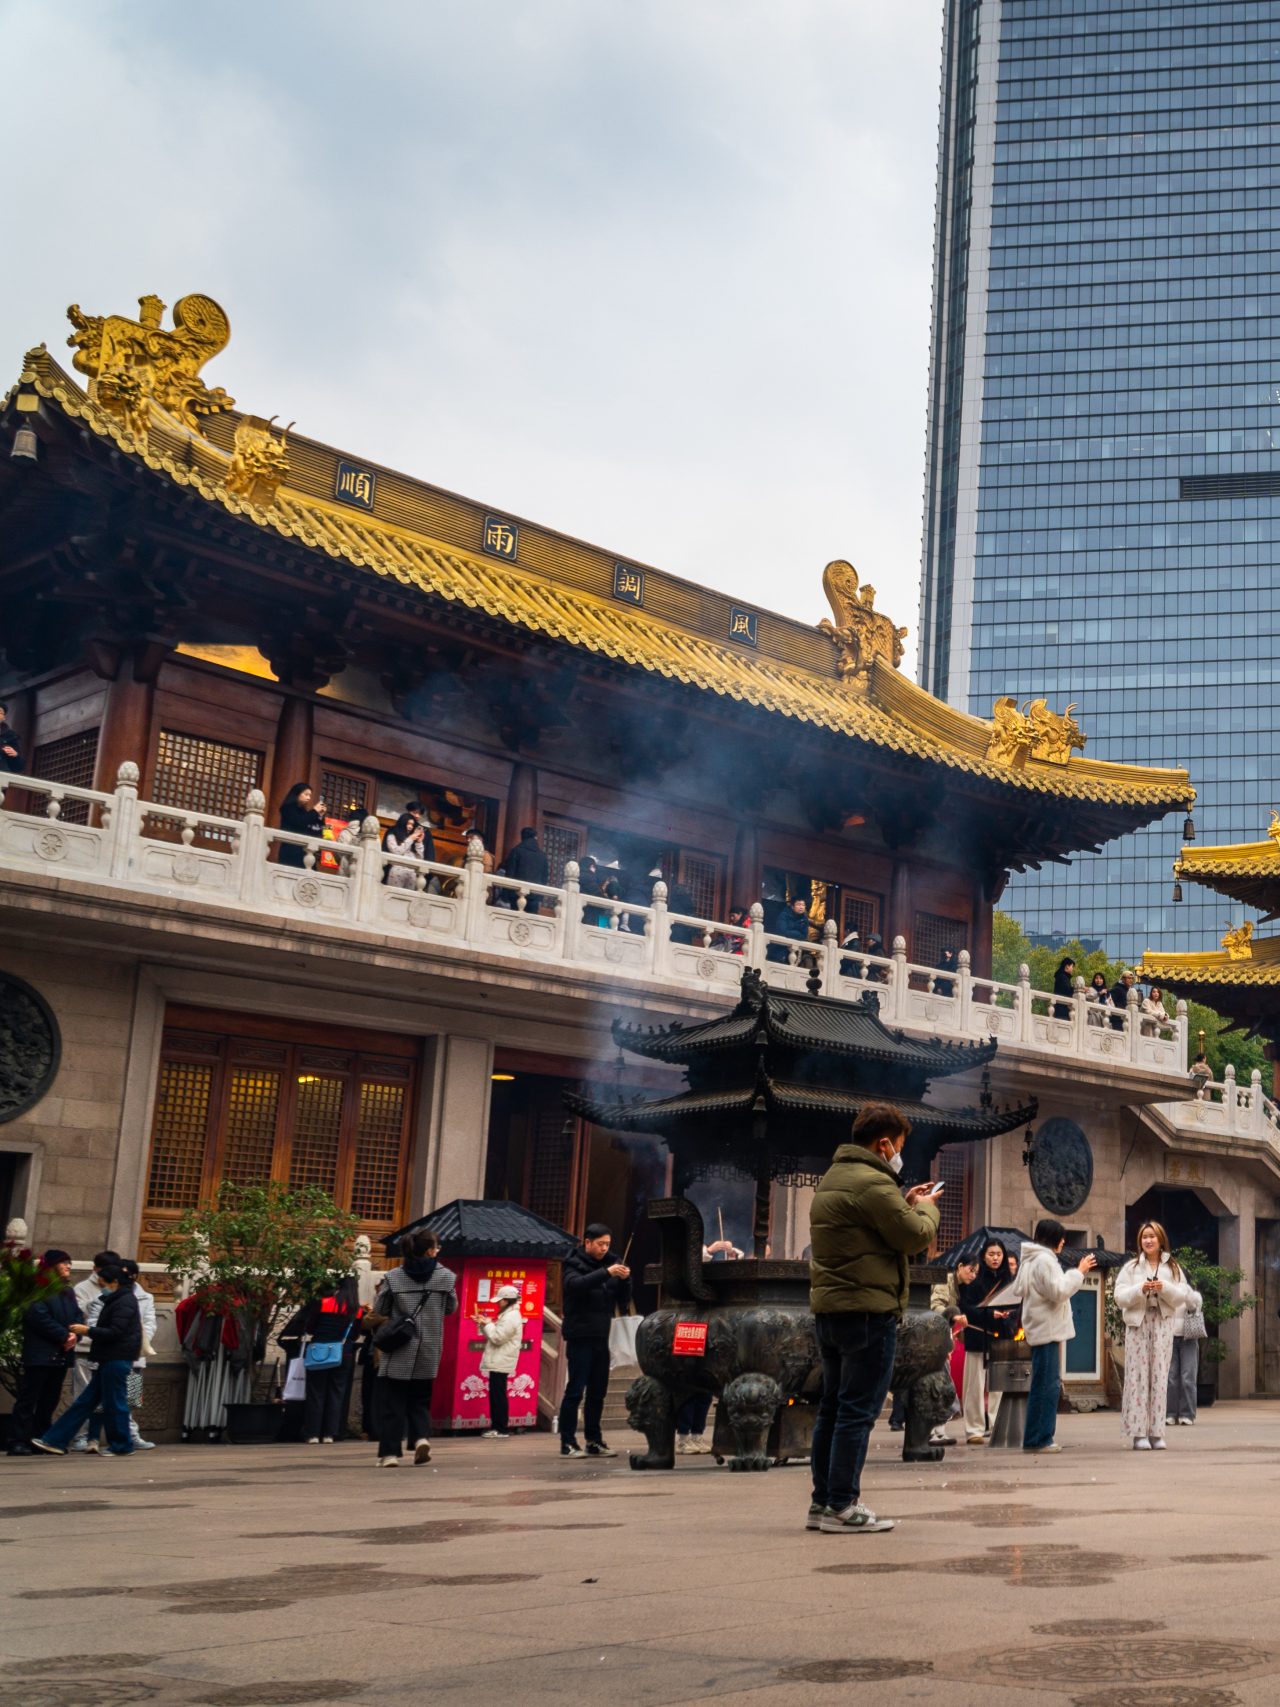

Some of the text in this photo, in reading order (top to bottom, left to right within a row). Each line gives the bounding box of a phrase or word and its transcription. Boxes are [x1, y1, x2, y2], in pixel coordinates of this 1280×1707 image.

[340, 472, 754, 641] 順 雨 調 風
